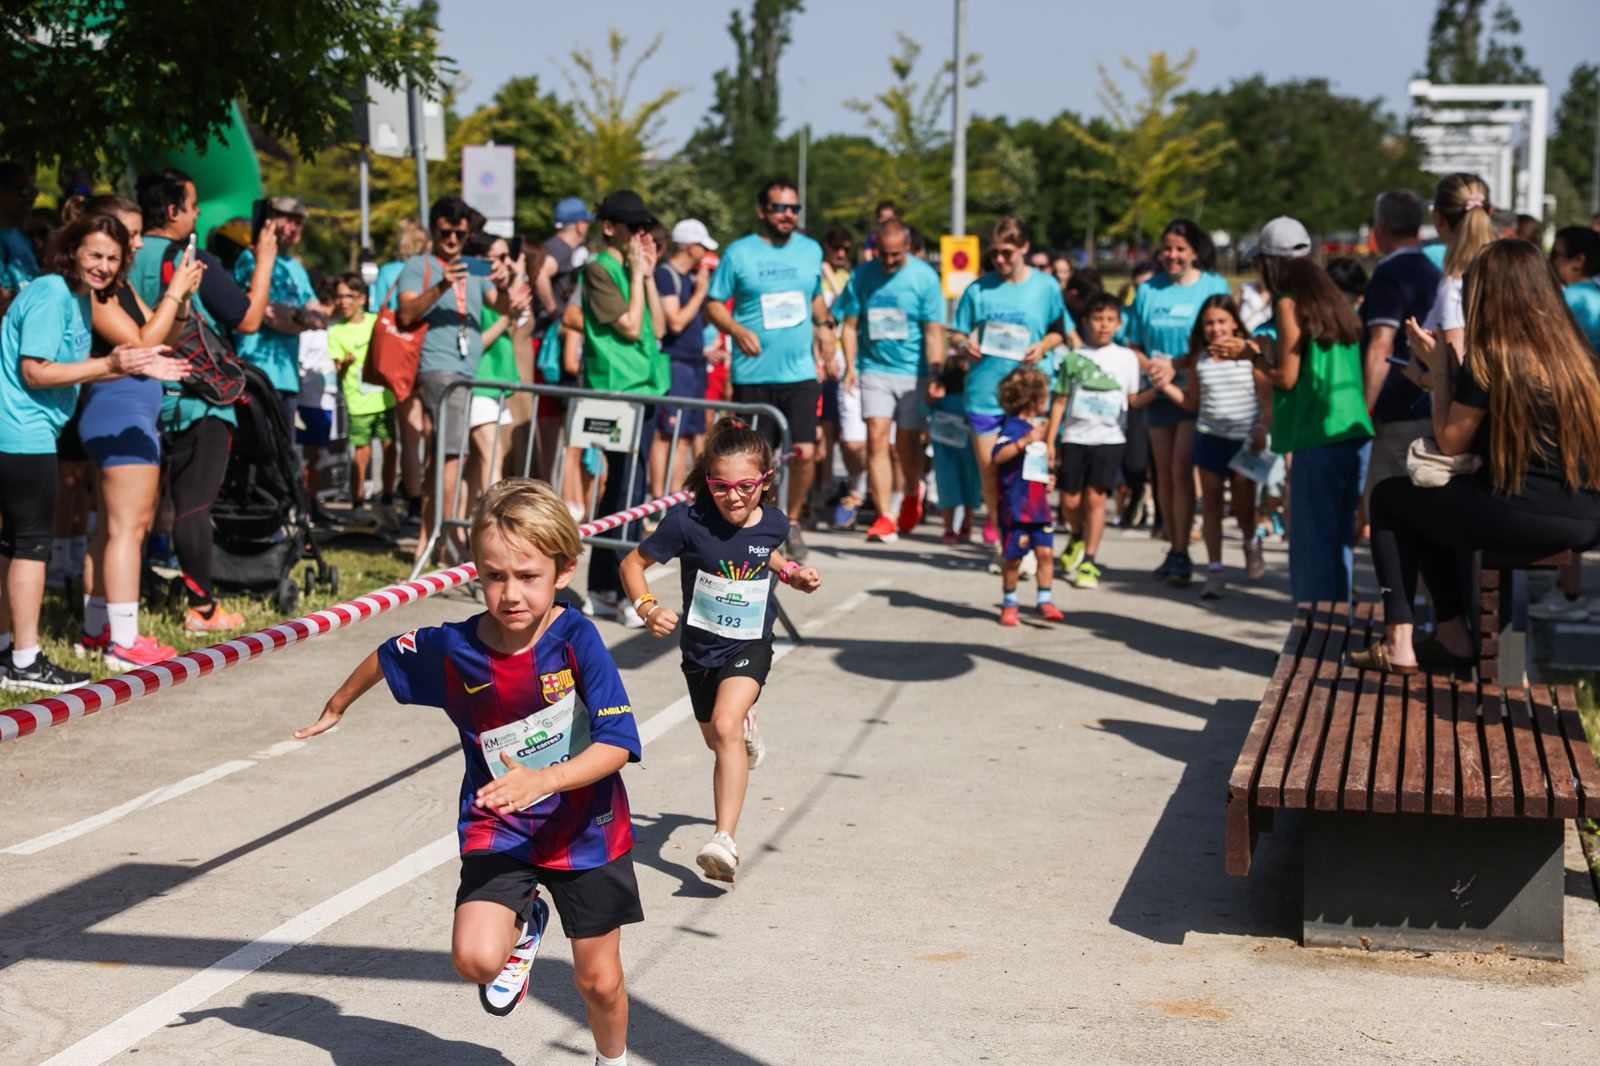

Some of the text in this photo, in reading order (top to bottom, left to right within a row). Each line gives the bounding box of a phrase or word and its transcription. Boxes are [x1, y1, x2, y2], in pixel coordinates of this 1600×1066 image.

[716, 615, 741, 628] 193
[598, 705, 633, 717] AMBILIG
[484, 737, 499, 750] KM
[524, 746, 537, 756] qui
[536, 734, 561, 749] corres?
